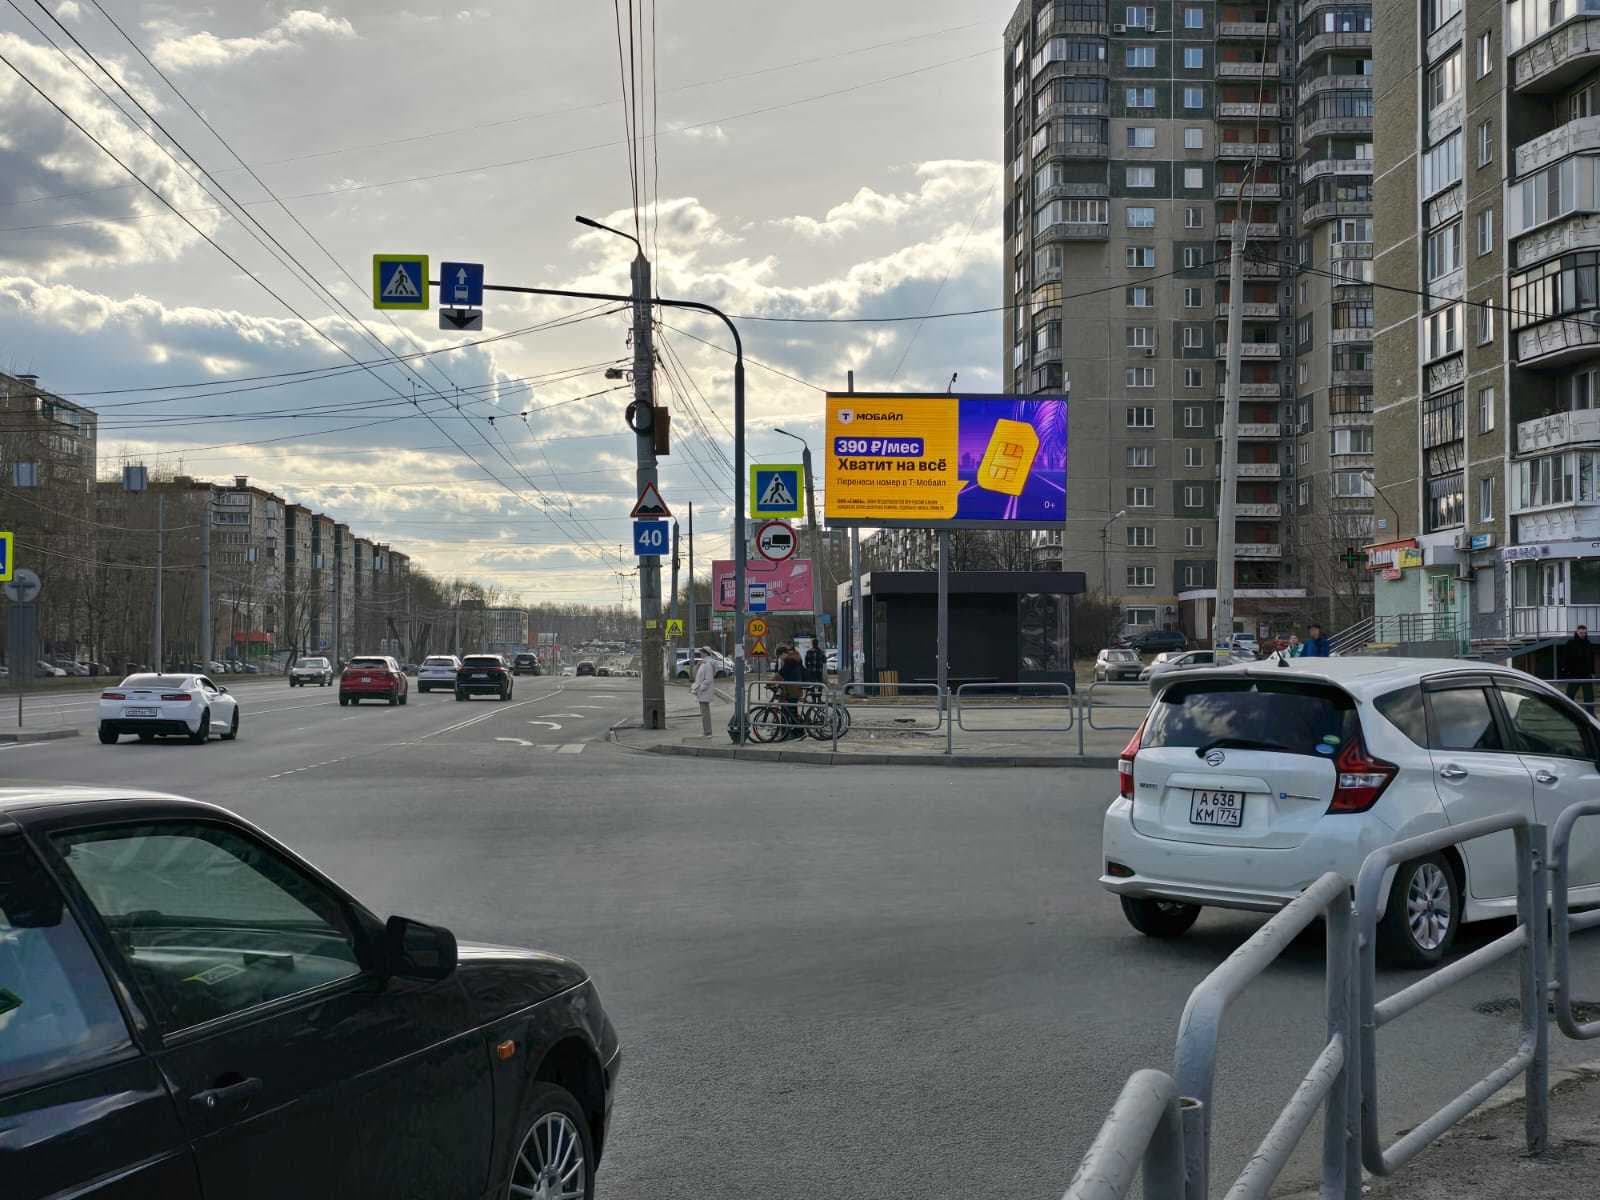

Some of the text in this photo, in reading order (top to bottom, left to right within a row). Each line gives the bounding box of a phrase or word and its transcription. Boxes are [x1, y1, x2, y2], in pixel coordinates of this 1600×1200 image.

[856, 411, 903, 421] МОБАЙЛ
[838, 440, 868, 454] 390
[837, 458, 947, 471] Хватит на всё
[876, 479, 901, 487] номер
[1044, 500, 1056, 509] 0+
[639, 529, 662, 546] 40
[751, 624, 763, 632] 30
[1200, 792, 1234, 807] А 638
[1196, 808, 1237, 822] КМ 774
